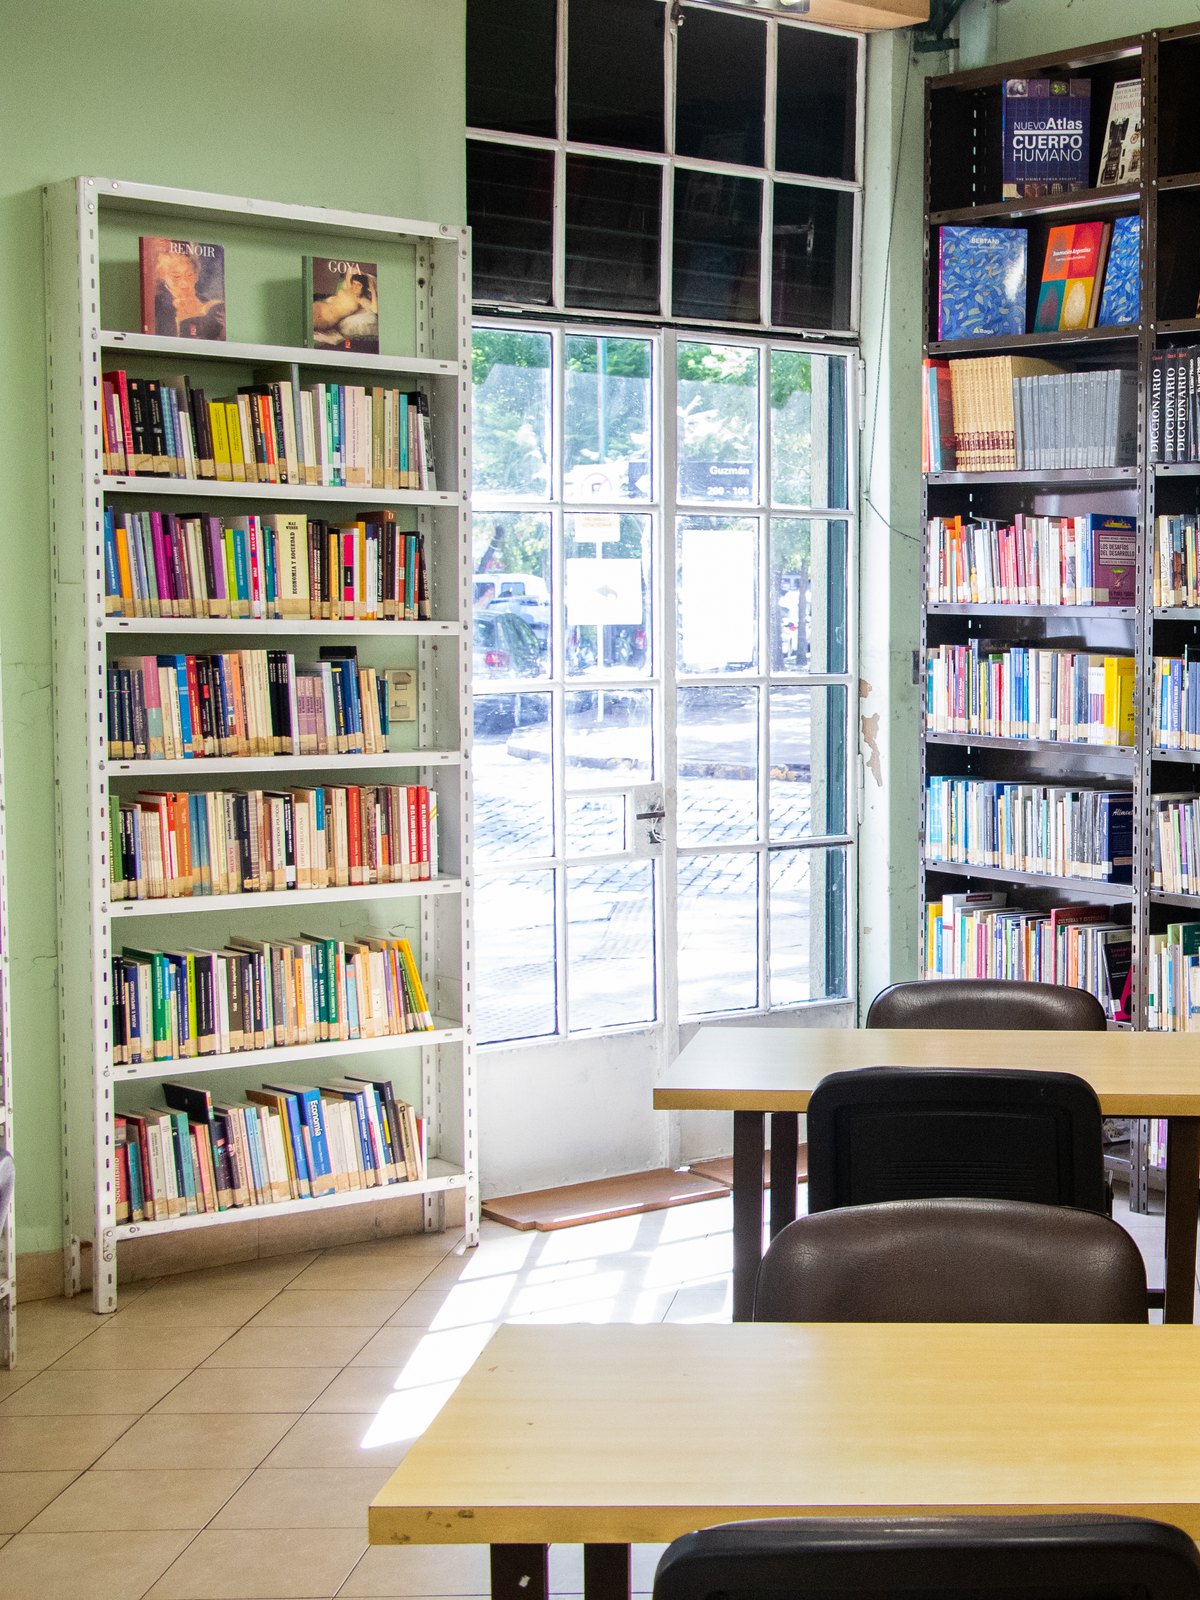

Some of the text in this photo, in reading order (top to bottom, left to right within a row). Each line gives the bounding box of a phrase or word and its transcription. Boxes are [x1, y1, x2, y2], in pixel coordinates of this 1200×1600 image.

[1014, 118, 1082, 130] NUEVO Atlas
[1013, 136, 1082, 149] CUERPO
[1013, 149, 1082, 162] HUMANO
[169, 242, 216, 258] RENOIR
[328, 260, 362, 276] GOYA
[1151, 368, 1161, 453] DICCIONARIO
[1166, 368, 1175, 452] DICCIONARIO
[1177, 366, 1186, 452] DICCIONARIO
[709, 466, 750, 476] Guzmán
[706, 487, 724, 496] 200
[732, 486, 749, 496] 100
[310, 1100, 322, 1136] Economía
